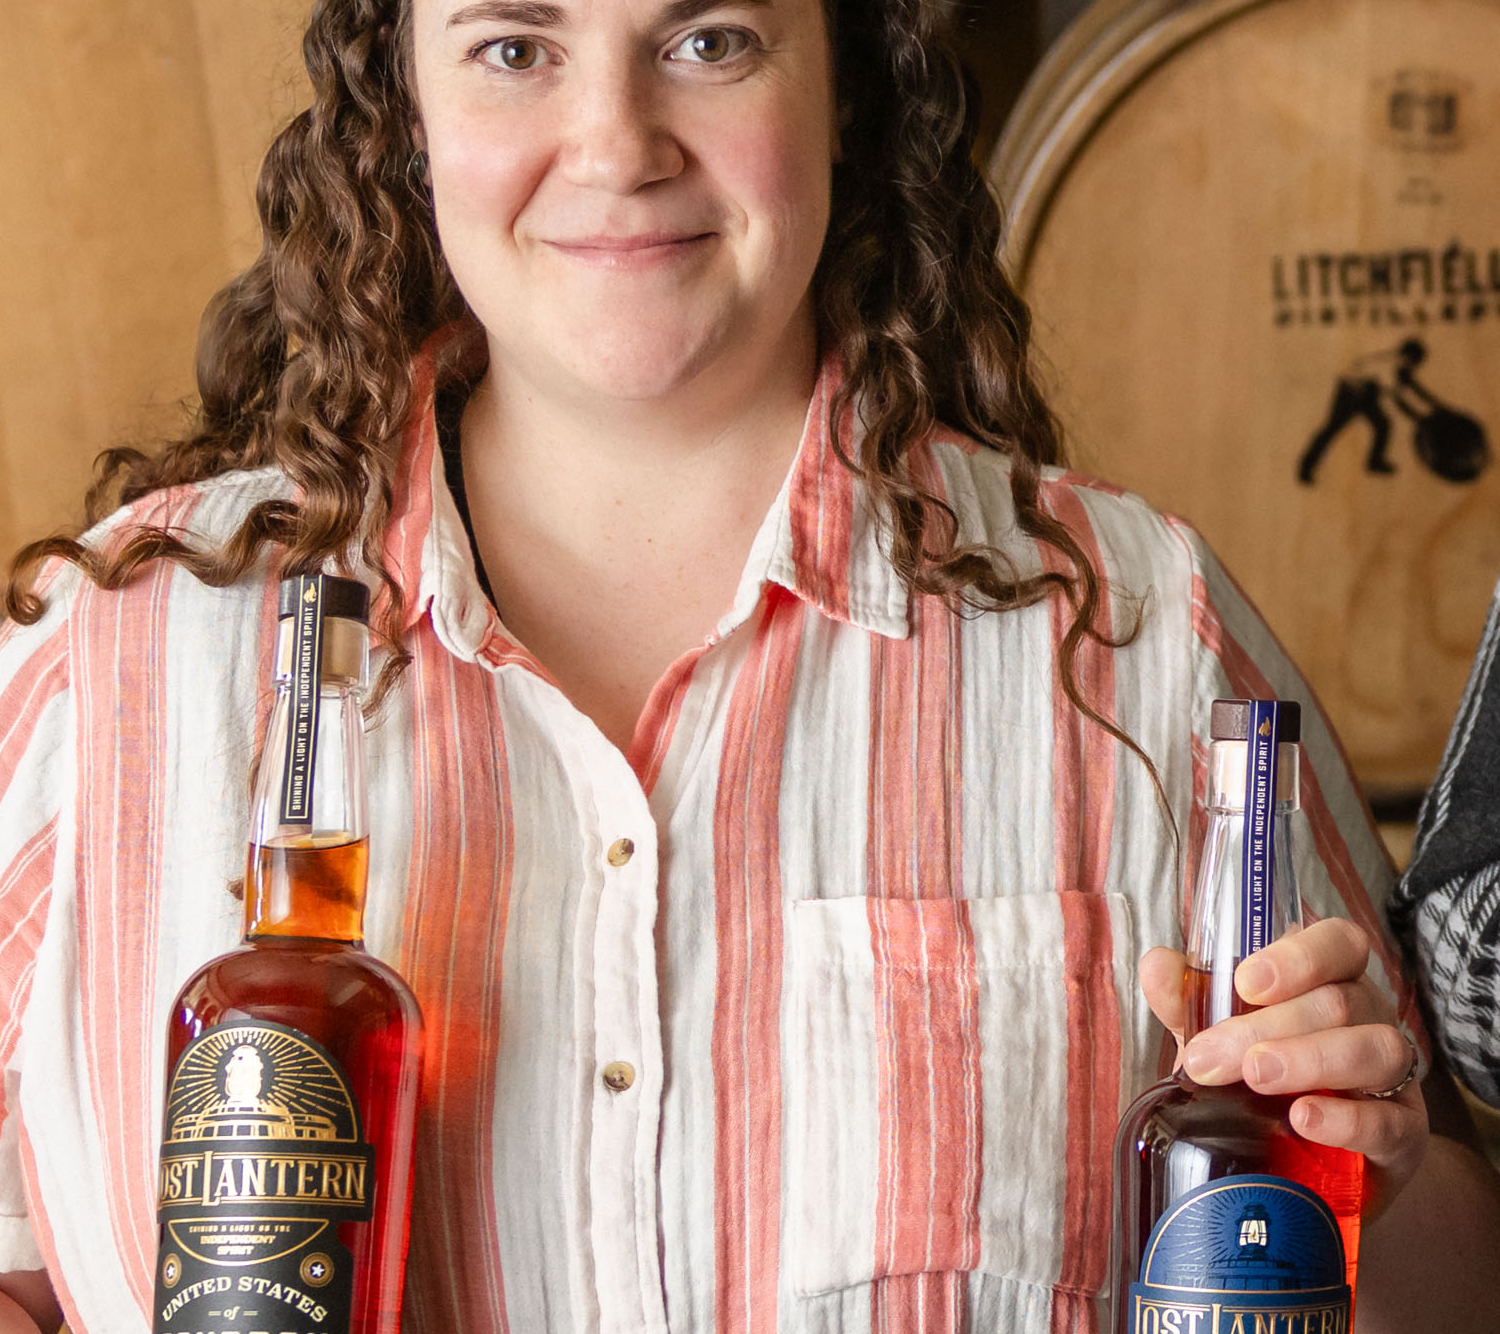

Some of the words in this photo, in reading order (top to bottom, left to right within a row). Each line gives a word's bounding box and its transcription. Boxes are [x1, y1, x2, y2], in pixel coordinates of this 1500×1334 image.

[303, 606, 314, 636] SPIRIT
[301, 639, 313, 699] INDEPENDENT
[299, 702, 310, 719] THE
[298, 720, 308, 734] ON
[296, 737, 308, 763] LIGHT
[1258, 740, 1270, 772] SPIRIT
[295, 764, 304, 772] A
[291, 773, 304, 812] SHINING
[1254, 775, 1269, 836] INDEPENDENT
[1254, 838, 1264, 858] THE
[1254, 858, 1264, 872] ON
[1253, 874, 1264, 902] LIGHT
[1253, 904, 1263, 913] A
[1252, 915, 1263, 953] SHINING
[158, 1158, 200, 1202] OST
[201, 1150, 367, 1207] LANTERN
[161, 1276, 233, 1322] UNITED
[237, 1276, 329, 1323] STATES
[223, 1305, 241, 1320] of
